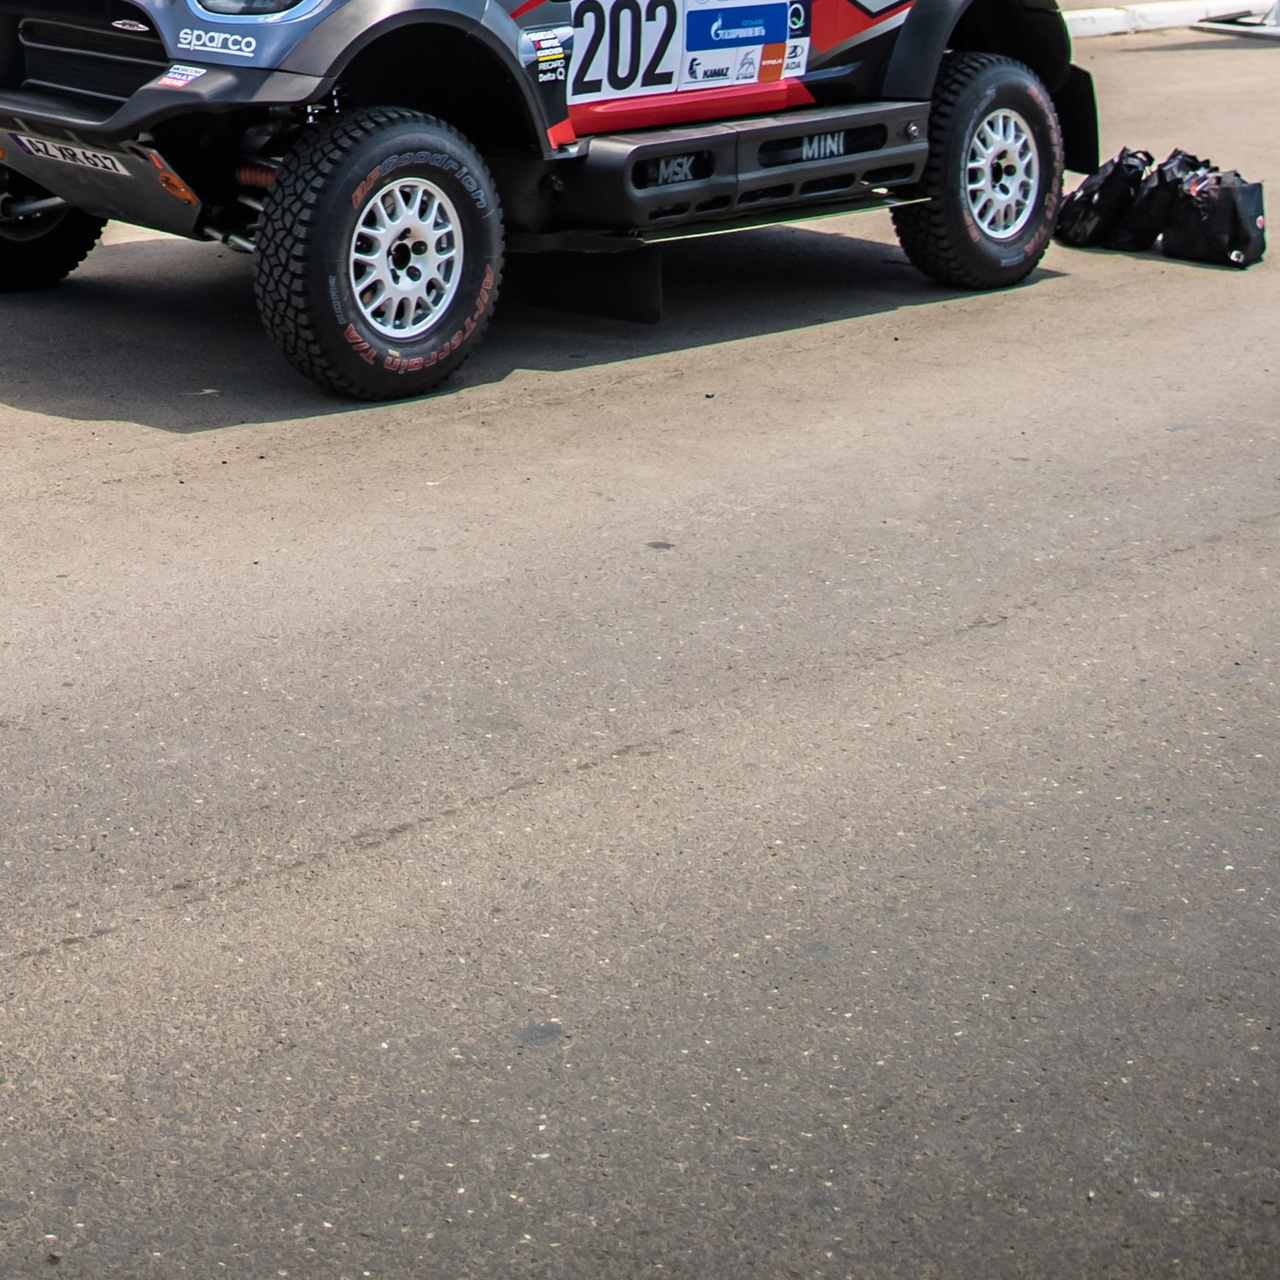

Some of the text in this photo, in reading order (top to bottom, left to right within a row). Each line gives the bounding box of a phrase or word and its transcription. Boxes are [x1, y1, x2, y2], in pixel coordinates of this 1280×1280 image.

[179, 28, 257, 52] sparco
[26, 138, 58, 159] AZ
[51, 144, 86, 165] XR
[801, 131, 845, 160] MINI
[658, 155, 696, 184] MSK
